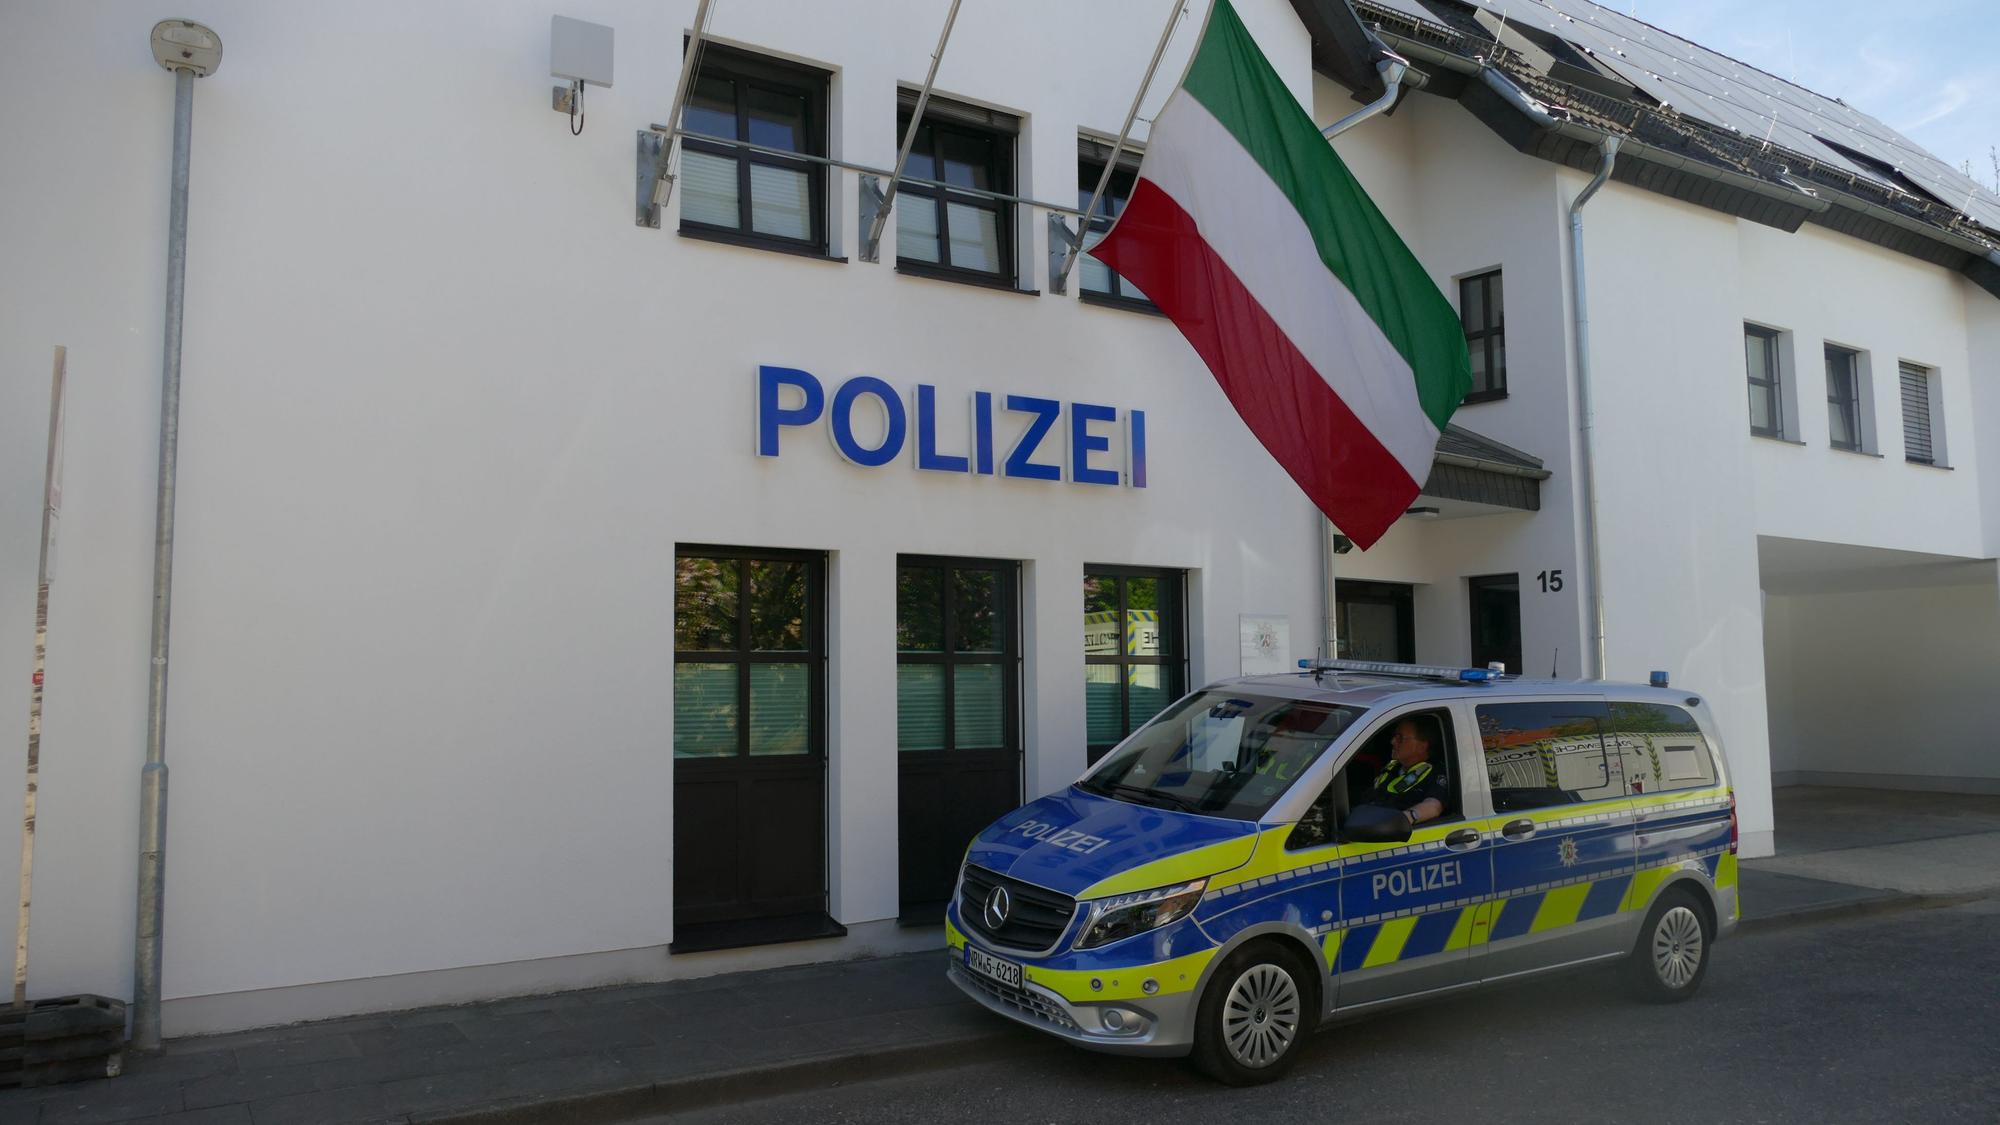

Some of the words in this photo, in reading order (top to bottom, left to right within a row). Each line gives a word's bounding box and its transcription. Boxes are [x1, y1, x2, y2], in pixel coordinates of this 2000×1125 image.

[756, 364, 1147, 489] POLIZEI
[1537, 569, 1563, 593] 15
[1009, 820, 1111, 854] POLIZEI
[1372, 860, 1462, 900] POLIZEI
